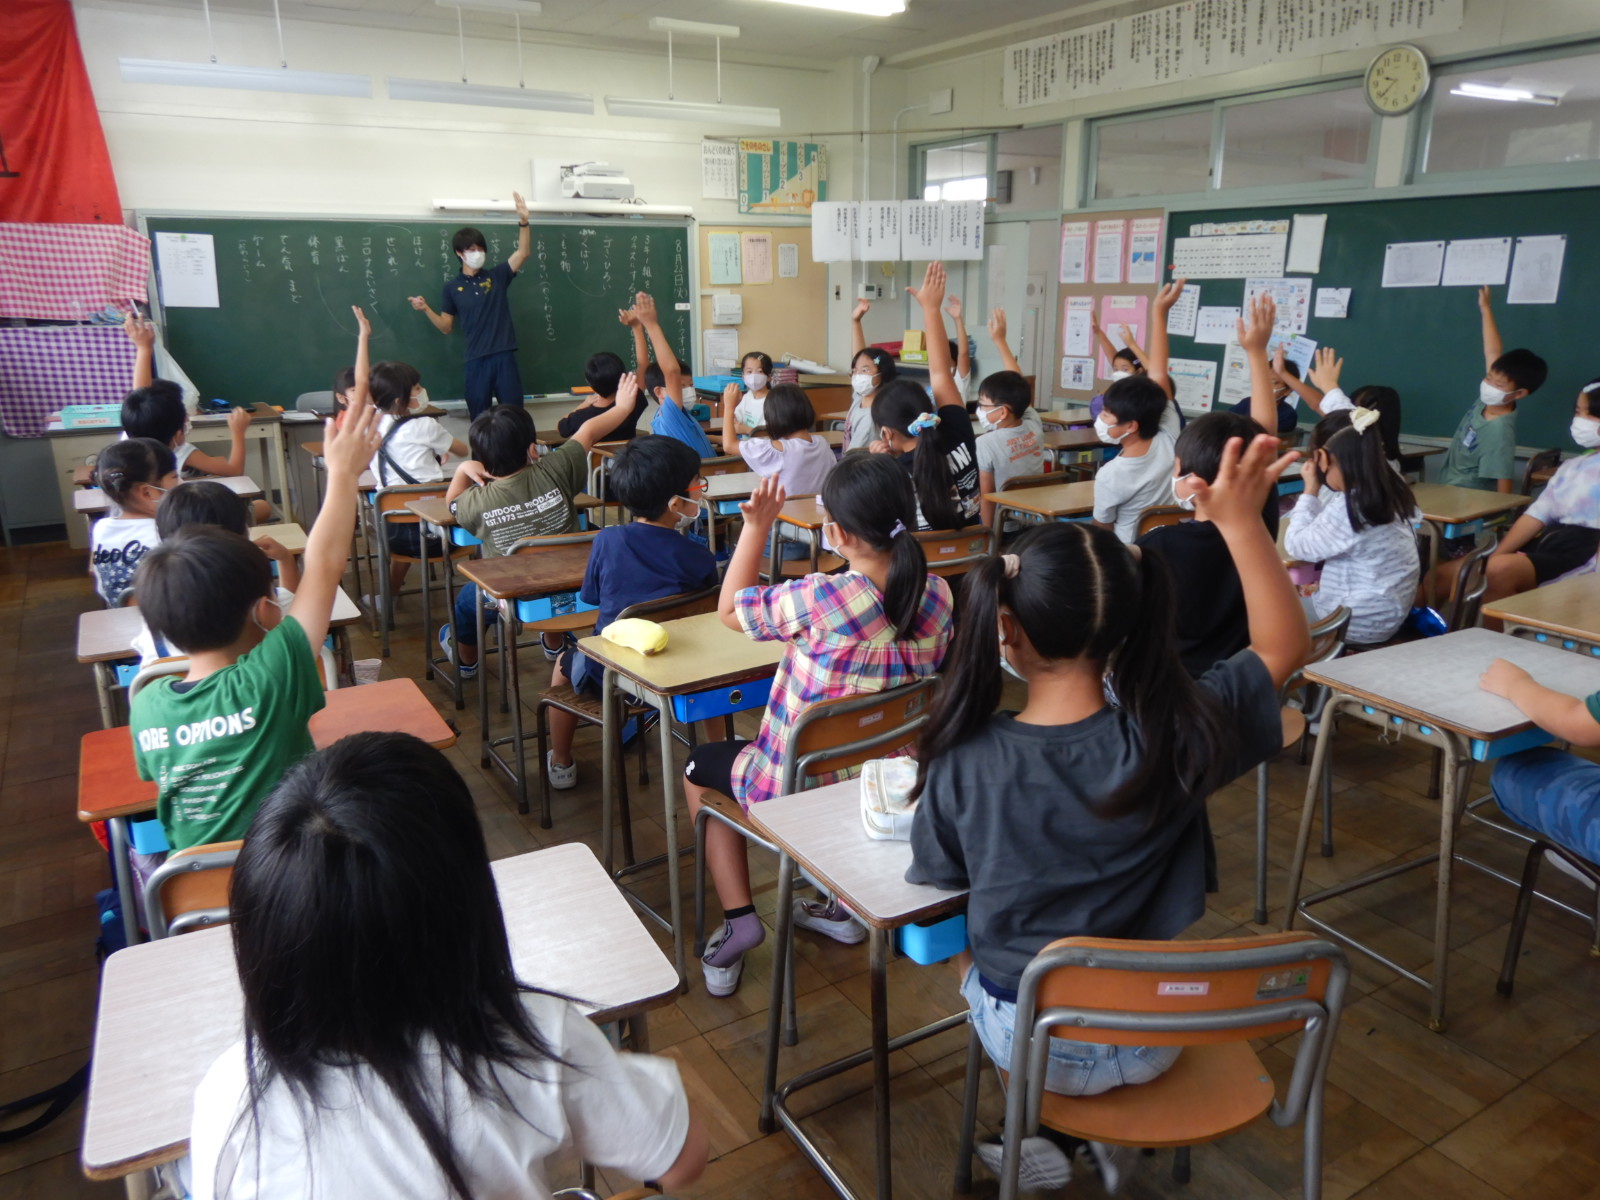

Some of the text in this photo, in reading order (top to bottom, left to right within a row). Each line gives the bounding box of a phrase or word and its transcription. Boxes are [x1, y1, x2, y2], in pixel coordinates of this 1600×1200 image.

[798, 171, 803, 181] 3
[780, 180, 786, 189] 2
[741, 194, 747, 203] 0
[413, 236, 426, 268] ほけん
[362, 236, 379, 314] コロナたいさく
[482, 504, 521, 519] OUTDOOR
[524, 488, 561, 508] PRODUCTS
[485, 514, 517, 527] EST.1973
[1265, 976, 1277, 987] 4
